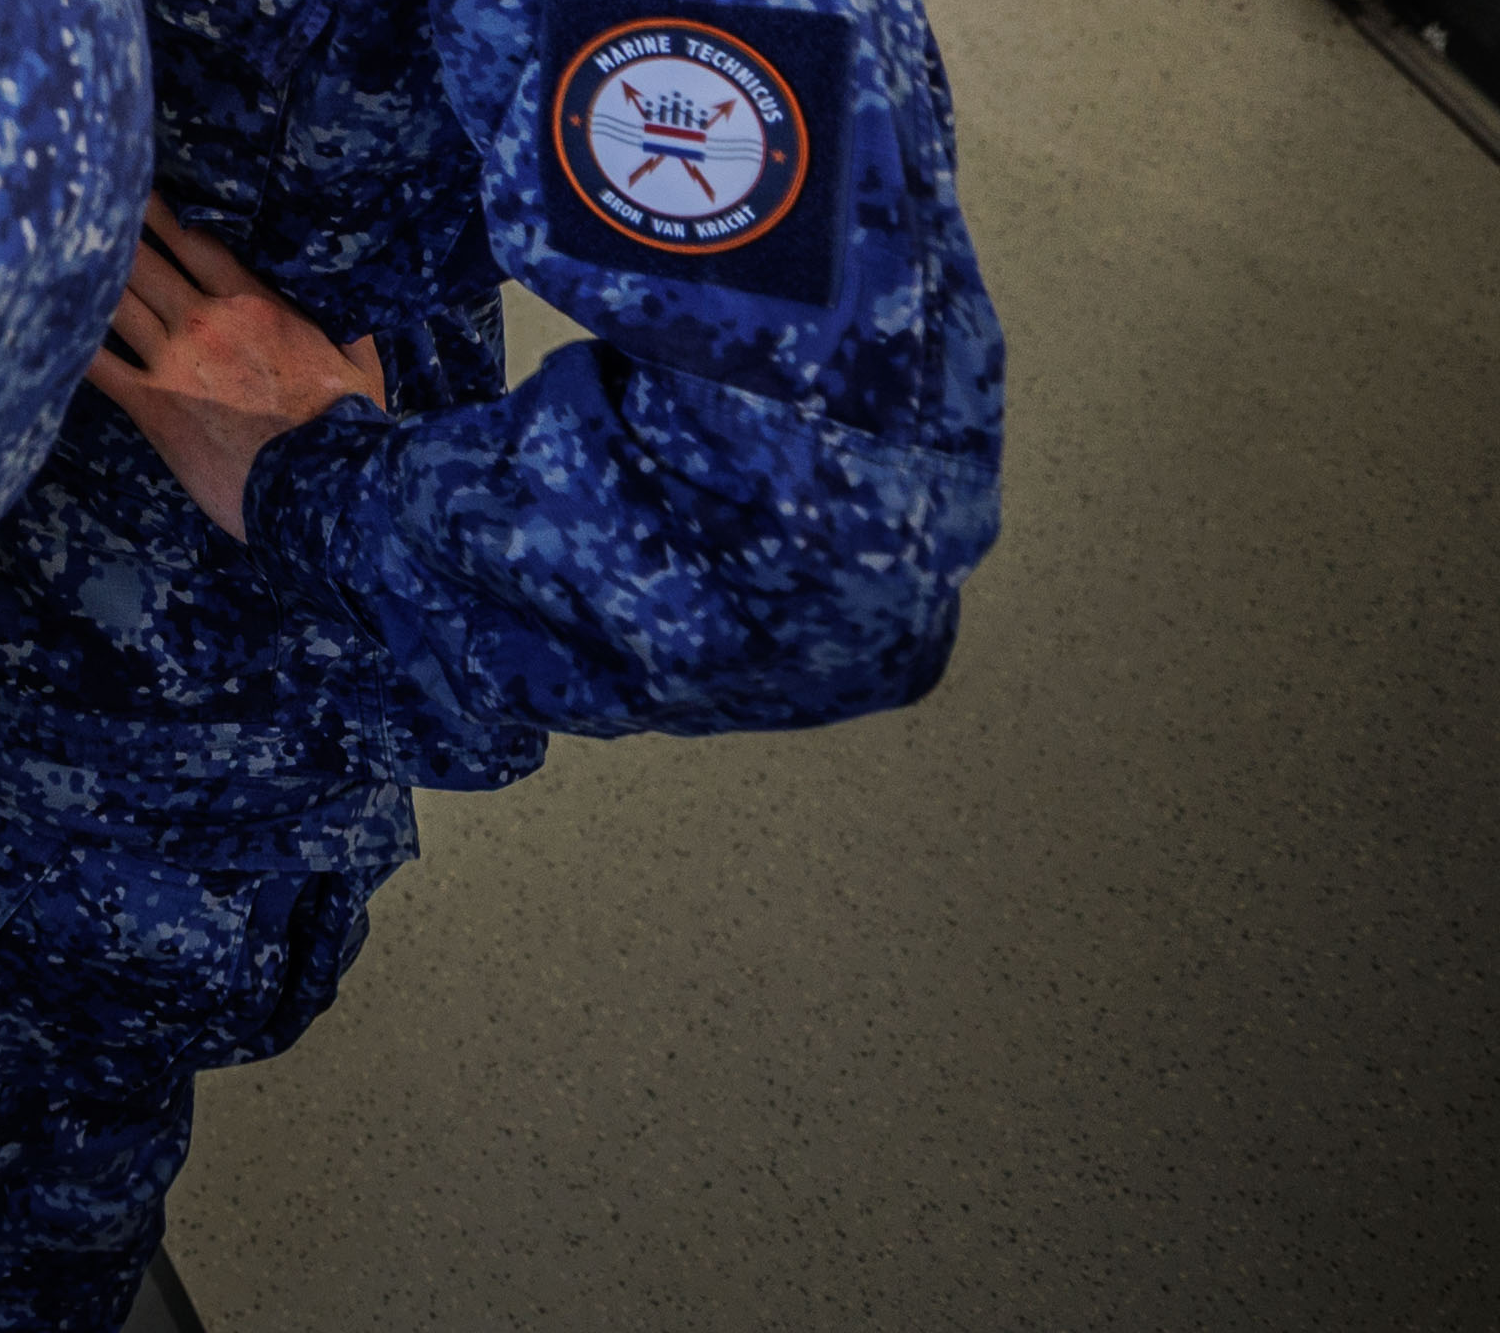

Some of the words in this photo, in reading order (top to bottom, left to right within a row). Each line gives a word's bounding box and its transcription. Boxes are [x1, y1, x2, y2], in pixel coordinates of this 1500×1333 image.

[593, 35, 672, 73] MARINE
[685, 38, 784, 123] TECHNICUS
[600, 190, 643, 225] BRON
[651, 218, 686, 238] VAN
[695, 205, 757, 238] KRACHT
